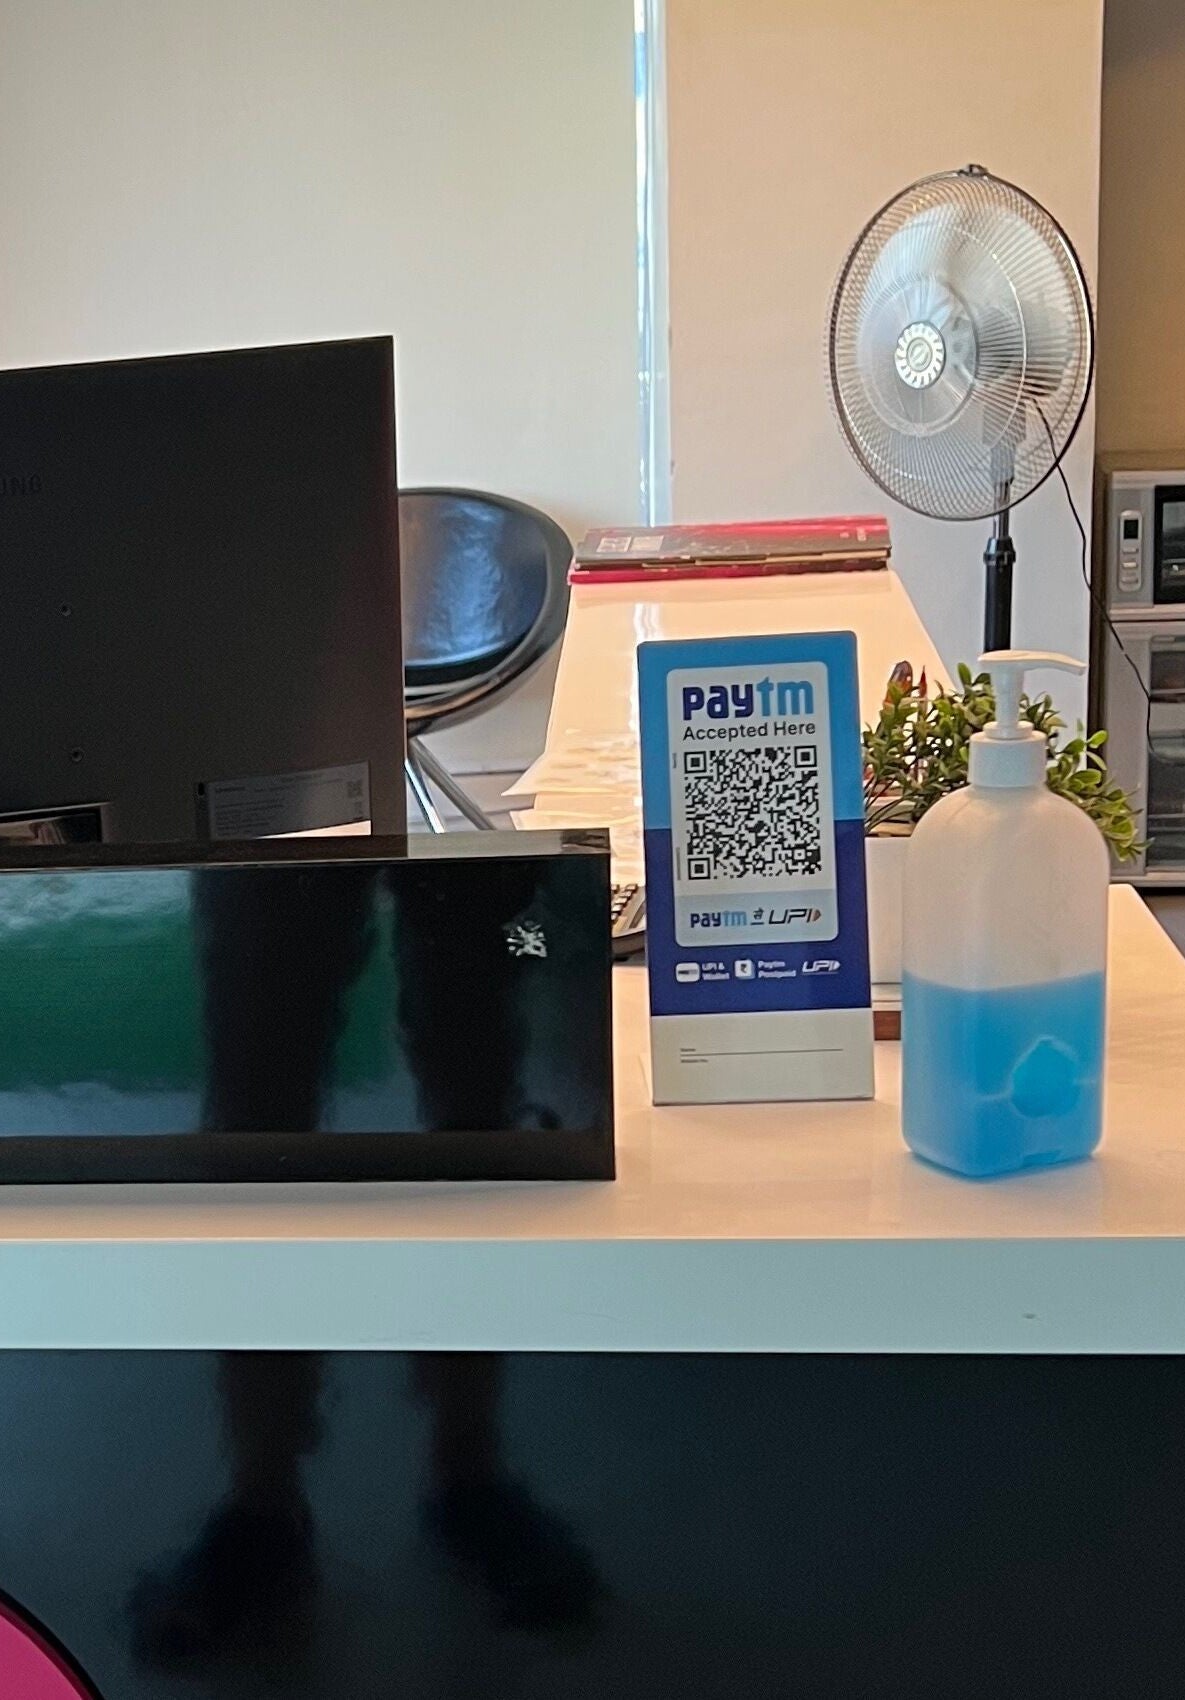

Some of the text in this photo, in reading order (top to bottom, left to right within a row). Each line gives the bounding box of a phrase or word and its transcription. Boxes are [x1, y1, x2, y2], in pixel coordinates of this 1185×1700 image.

[682, 721, 816, 742] Accepted Here
[702, 962, 717, 971] UPI
